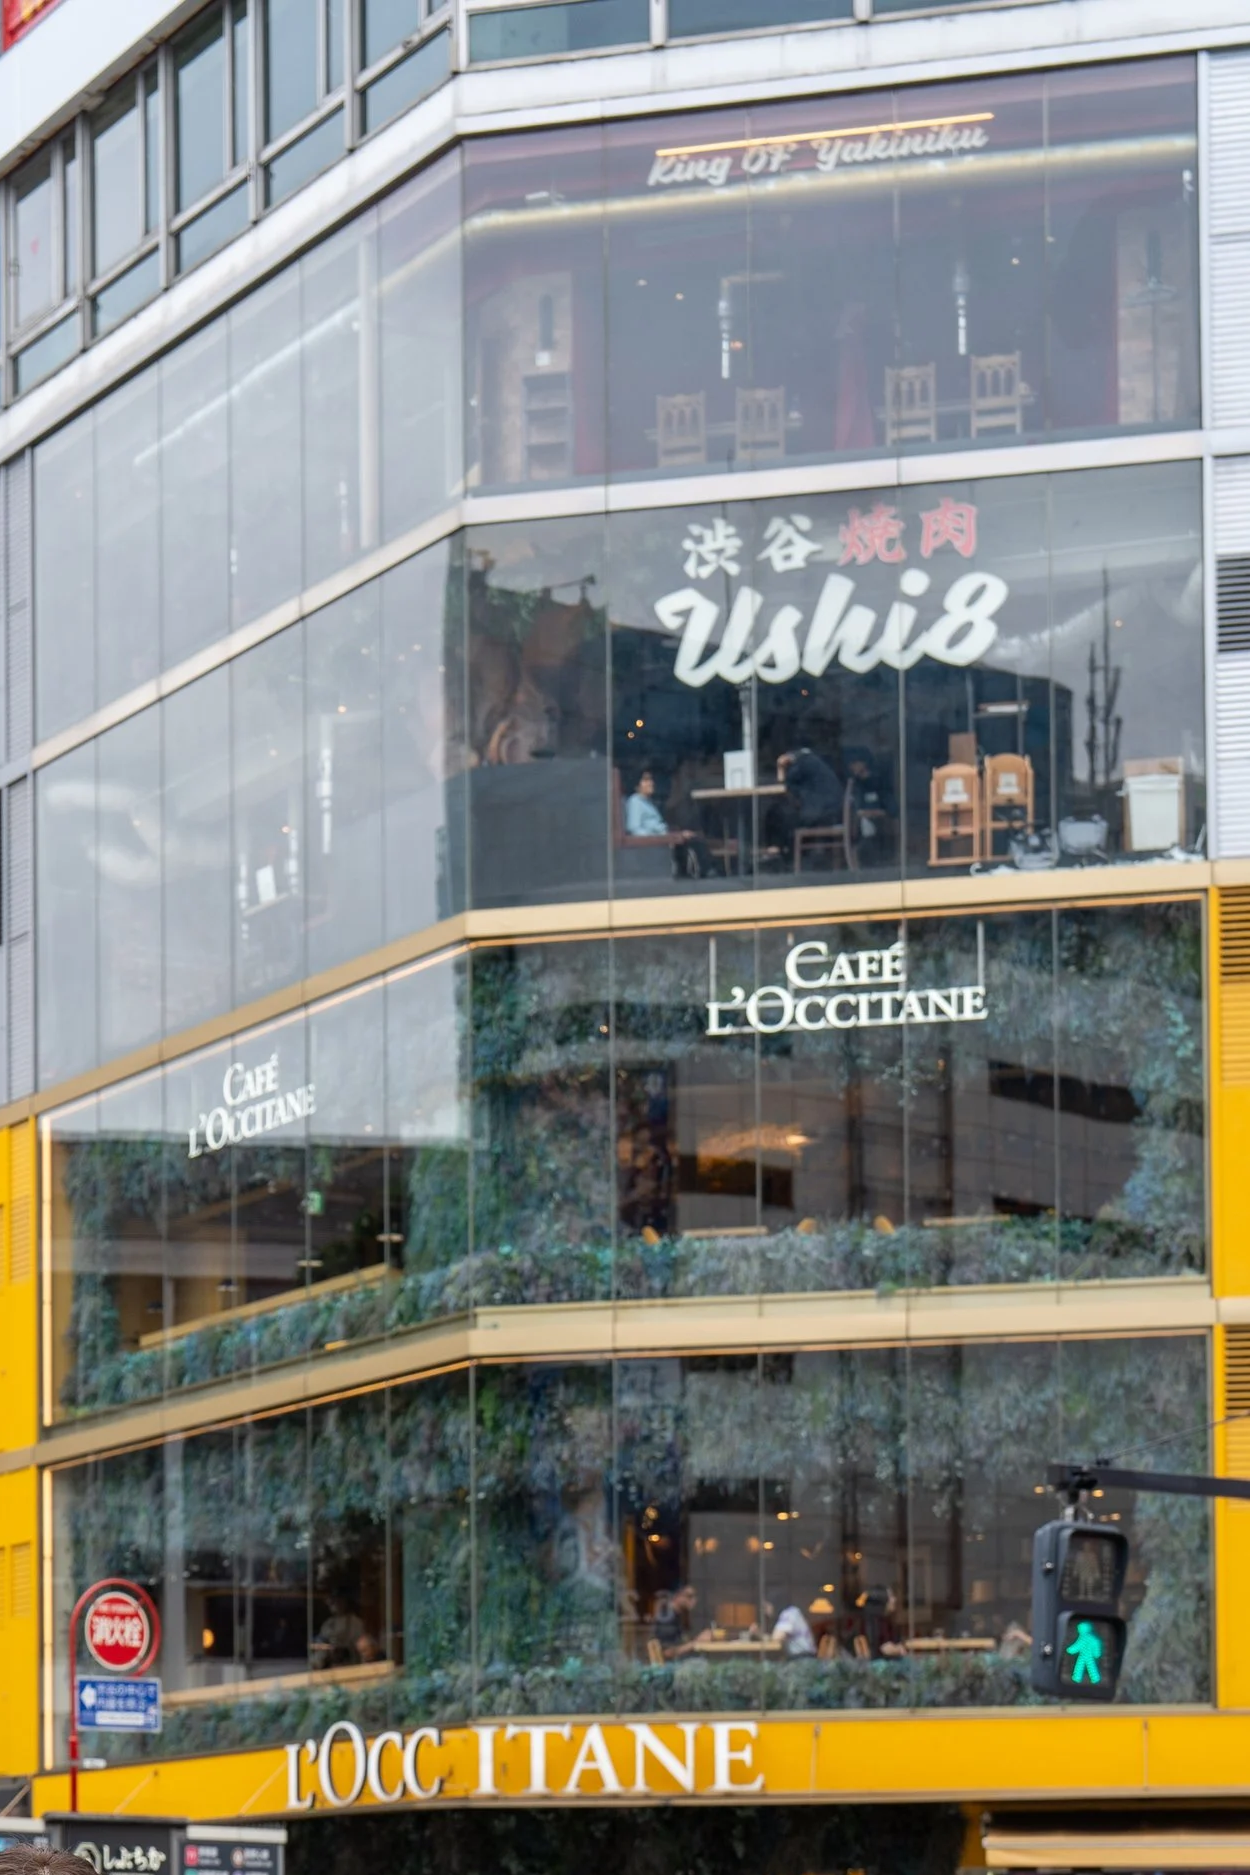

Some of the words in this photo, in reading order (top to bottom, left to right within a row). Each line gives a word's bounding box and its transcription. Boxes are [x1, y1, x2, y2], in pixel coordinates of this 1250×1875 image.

[648, 152, 732, 187] King
[810, 124, 989, 172] Yakiniku
[653, 568, 1009, 688] Ushi8
[91, 1614, 143, 1648] 消火栓
